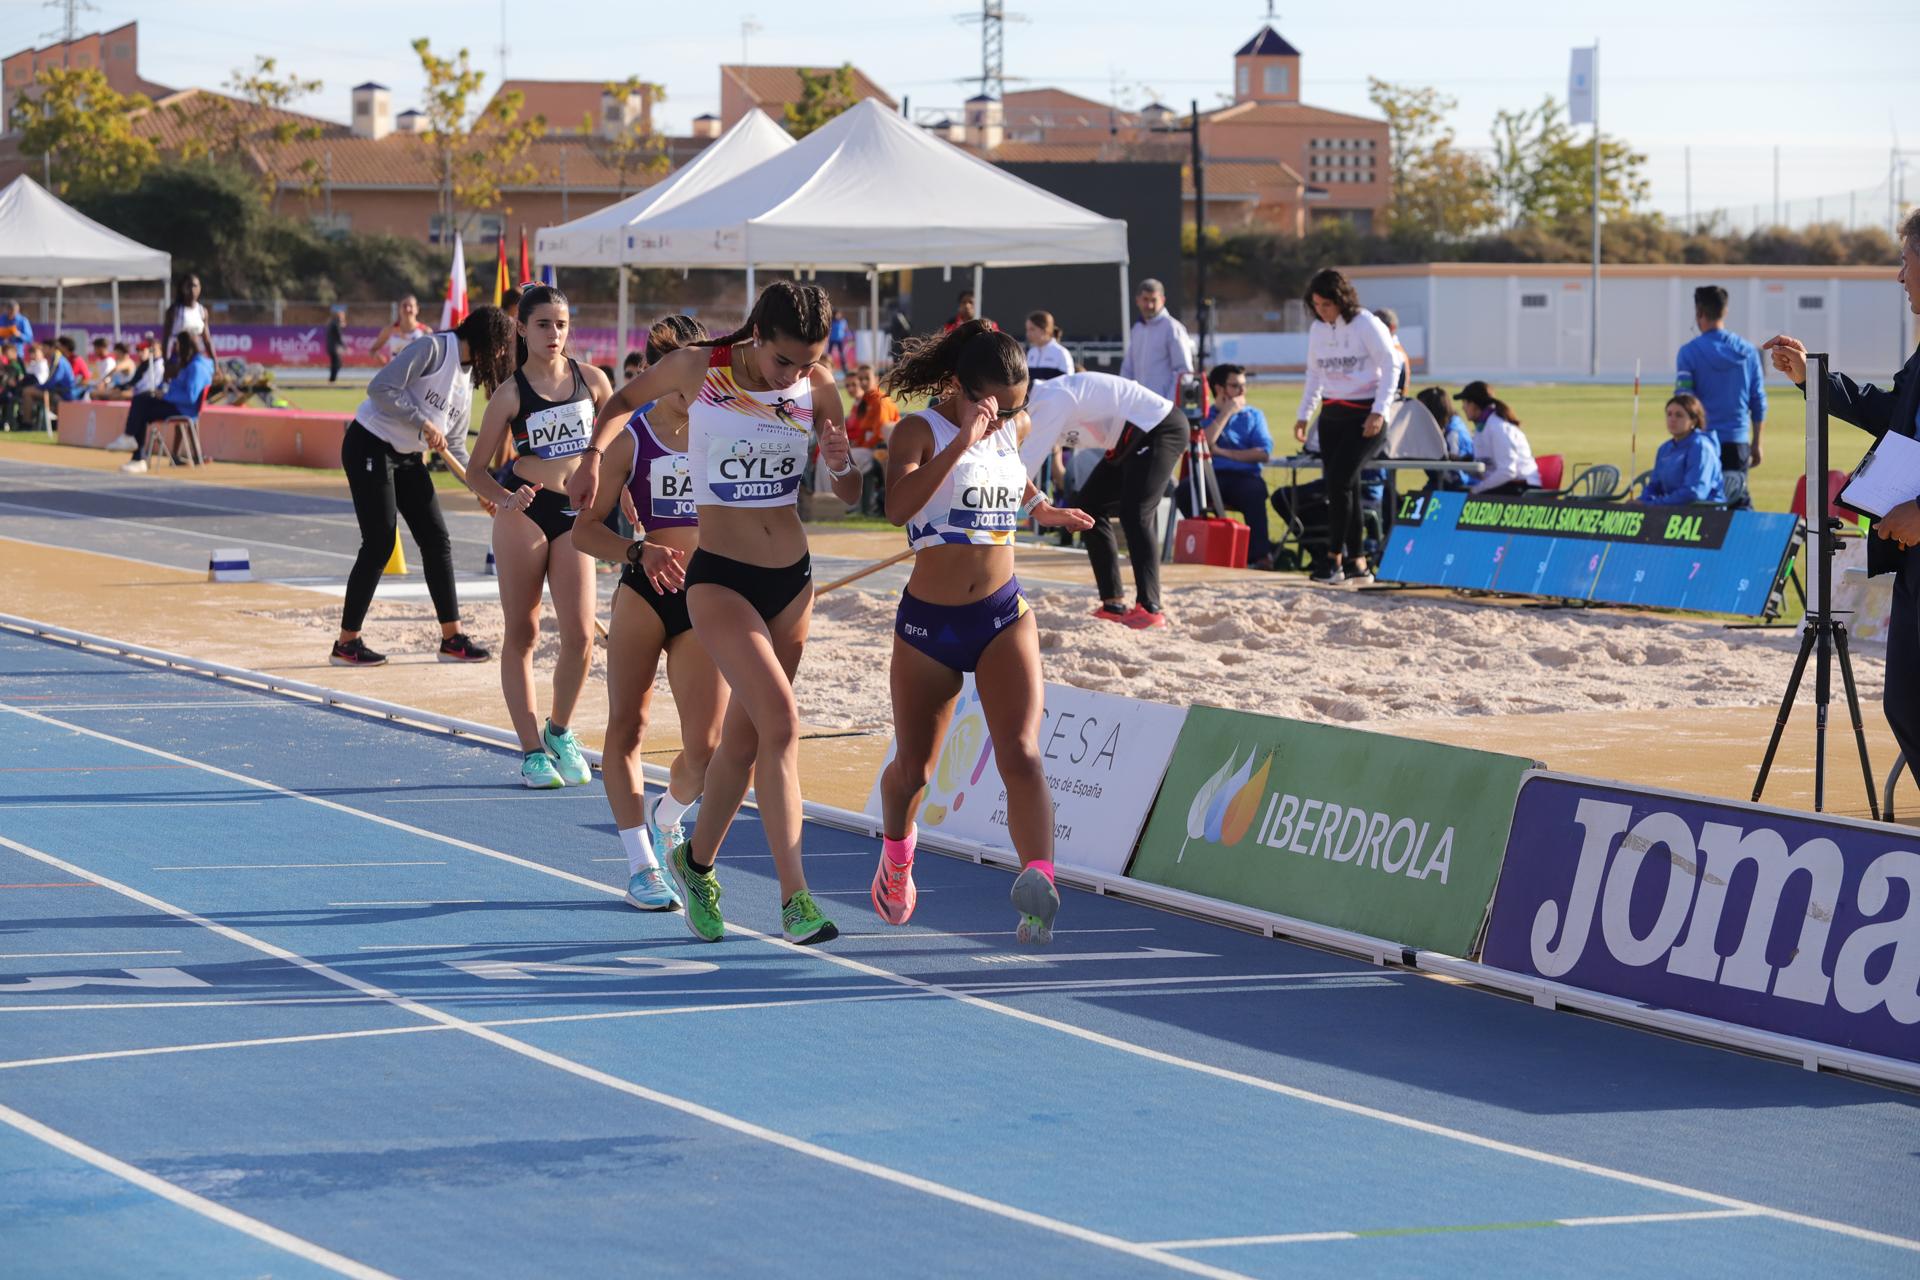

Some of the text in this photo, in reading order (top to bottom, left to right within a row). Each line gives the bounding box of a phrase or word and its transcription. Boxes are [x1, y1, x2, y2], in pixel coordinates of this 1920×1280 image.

[549, 440, 587, 457] Joma
[760, 442, 791, 450] CESA
[720, 458, 796, 480] CYL-8
[662, 475, 693, 497] BA
[733, 482, 784, 500] Joma
[971, 513, 1016, 527] Joma
[1459, 501, 1645, 537] SOLEDAD SOLDEVILLA SANCHEZ-MONTES
[1664, 515, 1702, 542] BAL
[1404, 539, 1415, 554] 4
[1493, 546, 1504, 563] 5
[1588, 554, 1599, 571] 6
[1688, 562, 1700, 580] 7
[1634, 570, 1645, 583] 50
[1737, 579, 1749, 592] 50
[912, 627, 928, 637] FCA
[1043, 708, 1121, 771] ESA
[1061, 777, 1073, 793] de
[1072, 780, 1103, 799] España
[1256, 792, 1454, 885] IBERDROLA
[1530, 798, 1920, 1025] Joma
